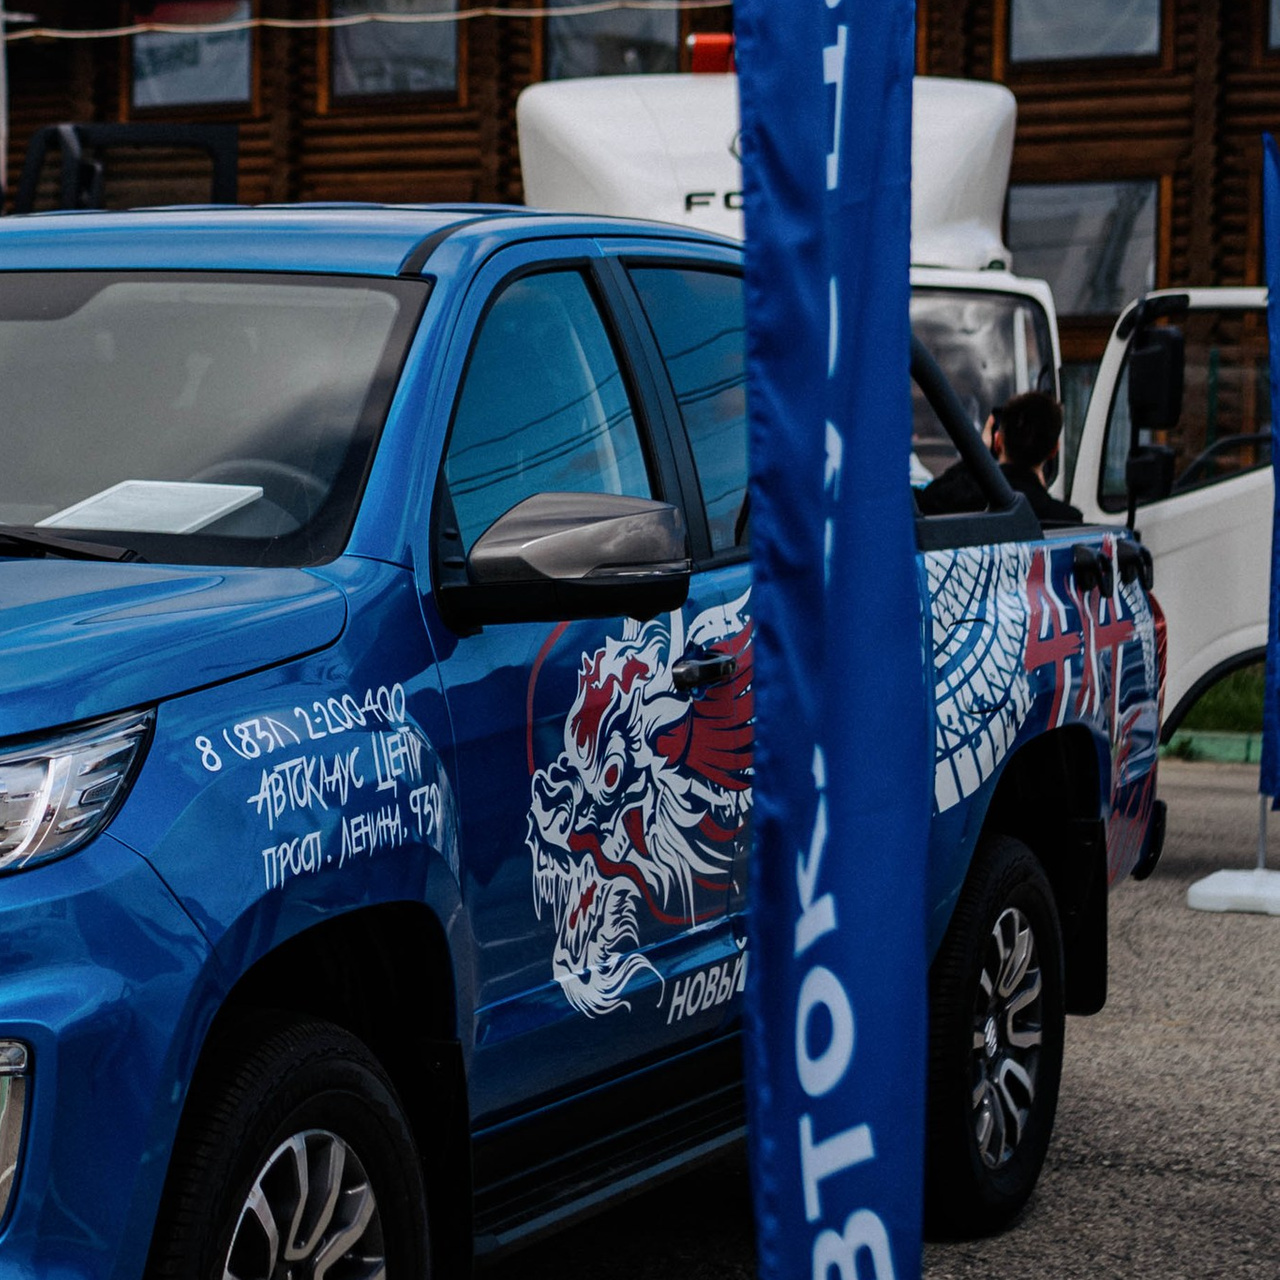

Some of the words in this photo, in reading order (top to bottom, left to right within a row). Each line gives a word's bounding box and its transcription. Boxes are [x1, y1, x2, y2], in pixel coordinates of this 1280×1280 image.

[194, 735, 222, 772] 8
[293, 682, 406, 740] 2-200-400
[246, 746, 364, 831] АВТОКЛАУС
[666, 936, 749, 1025] НОВЫЙ
